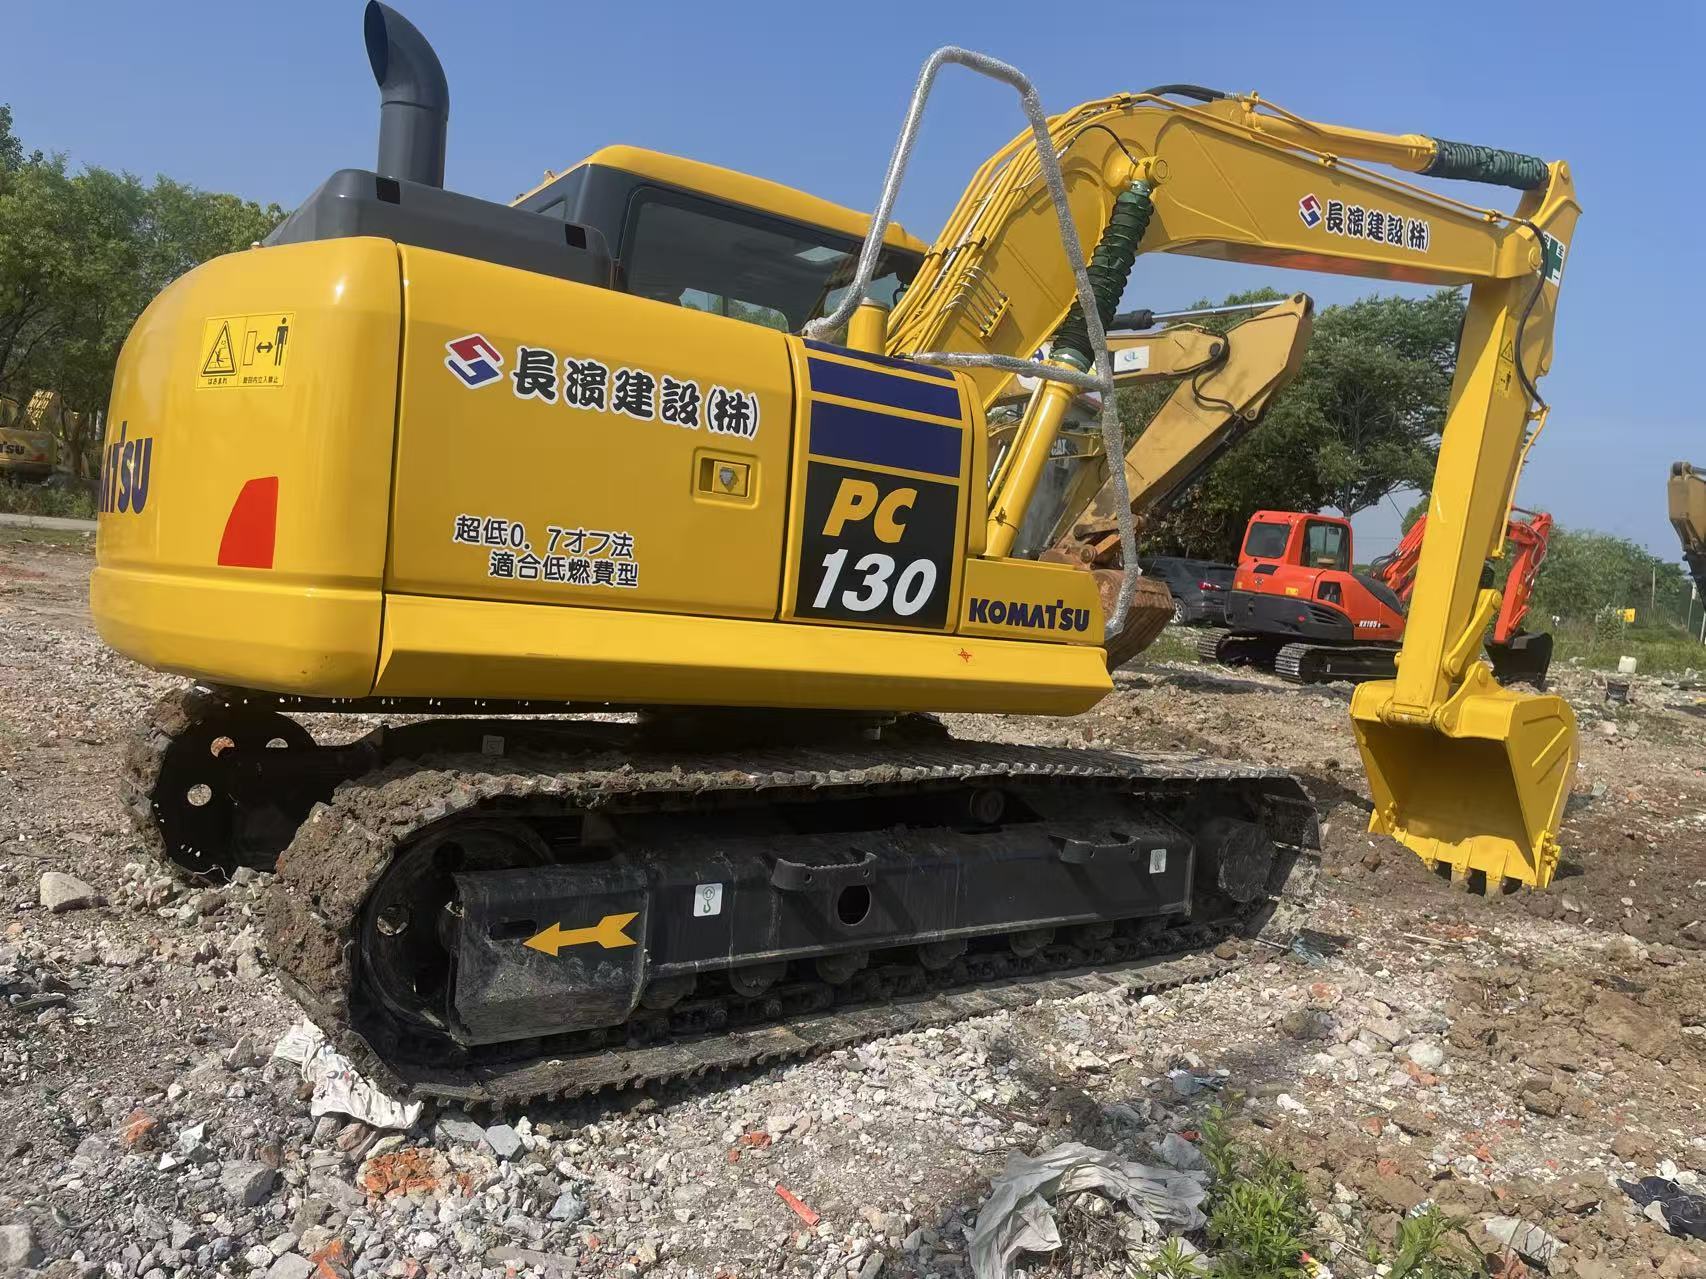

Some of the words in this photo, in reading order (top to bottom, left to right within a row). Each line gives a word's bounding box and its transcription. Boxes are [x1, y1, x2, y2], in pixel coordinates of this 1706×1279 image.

[821, 477, 919, 544] PC
[488, 550, 639, 588] 適合低燃費型
[811, 548, 938, 616] 130
[968, 597, 1090, 632] KOMATSU
